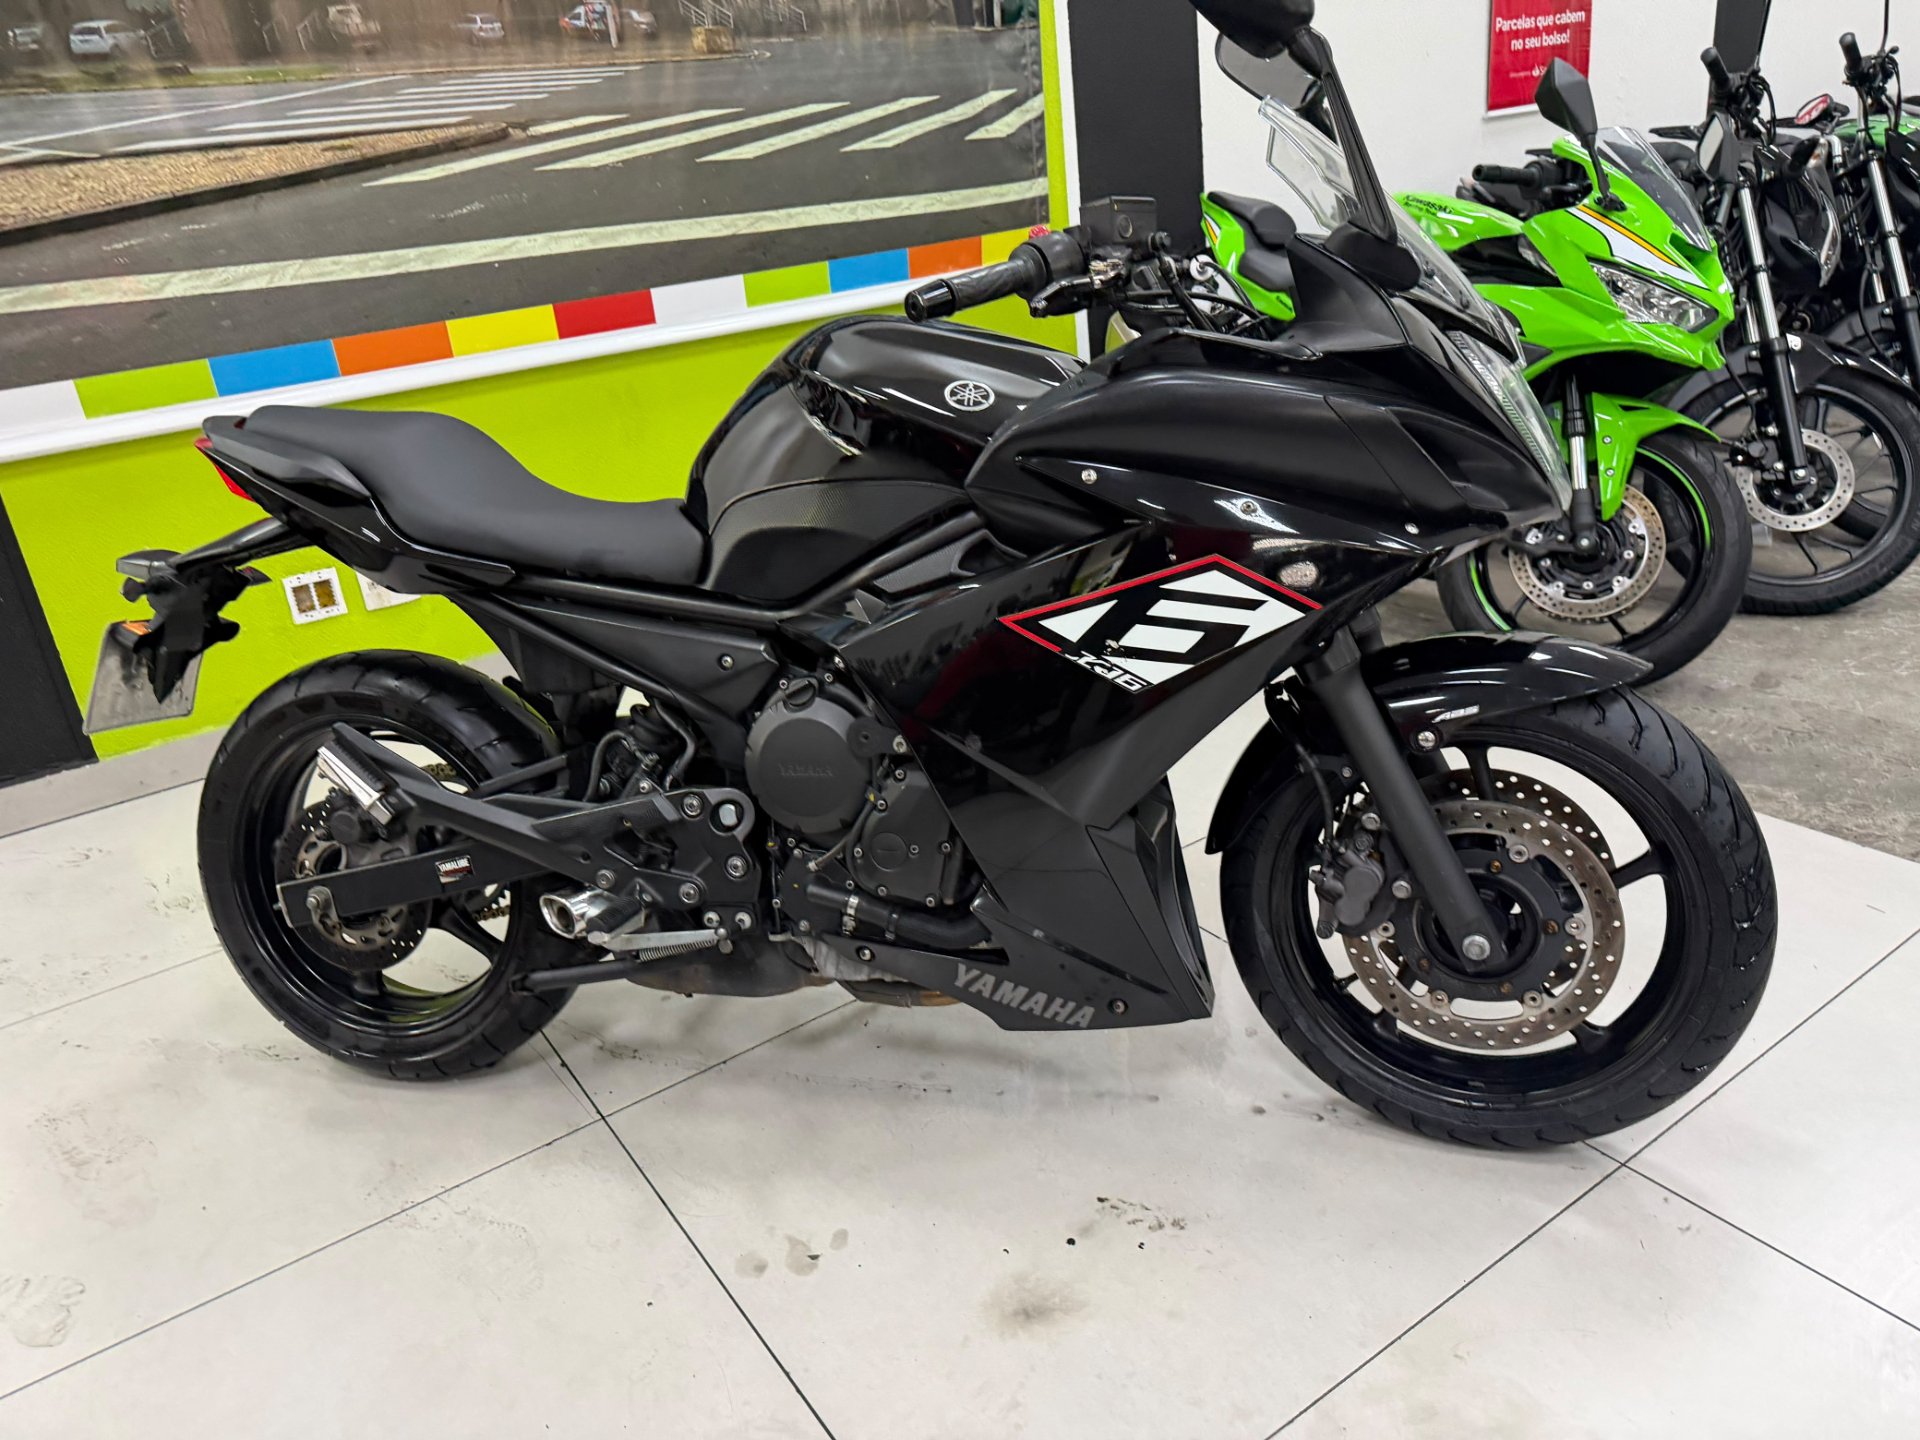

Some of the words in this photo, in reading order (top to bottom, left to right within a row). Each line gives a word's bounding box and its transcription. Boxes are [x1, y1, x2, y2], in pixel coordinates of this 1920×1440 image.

[1496, 14, 1535, 32] Parcelas
[1537, 16, 1553, 30] que
[1555, 9, 1585, 25] cabem
[1511, 38, 1522, 51] no
[1525, 36, 1541, 49] seu
[1542, 29, 1570, 47] bolso!
[954, 962, 1096, 1029] YAMAHA
